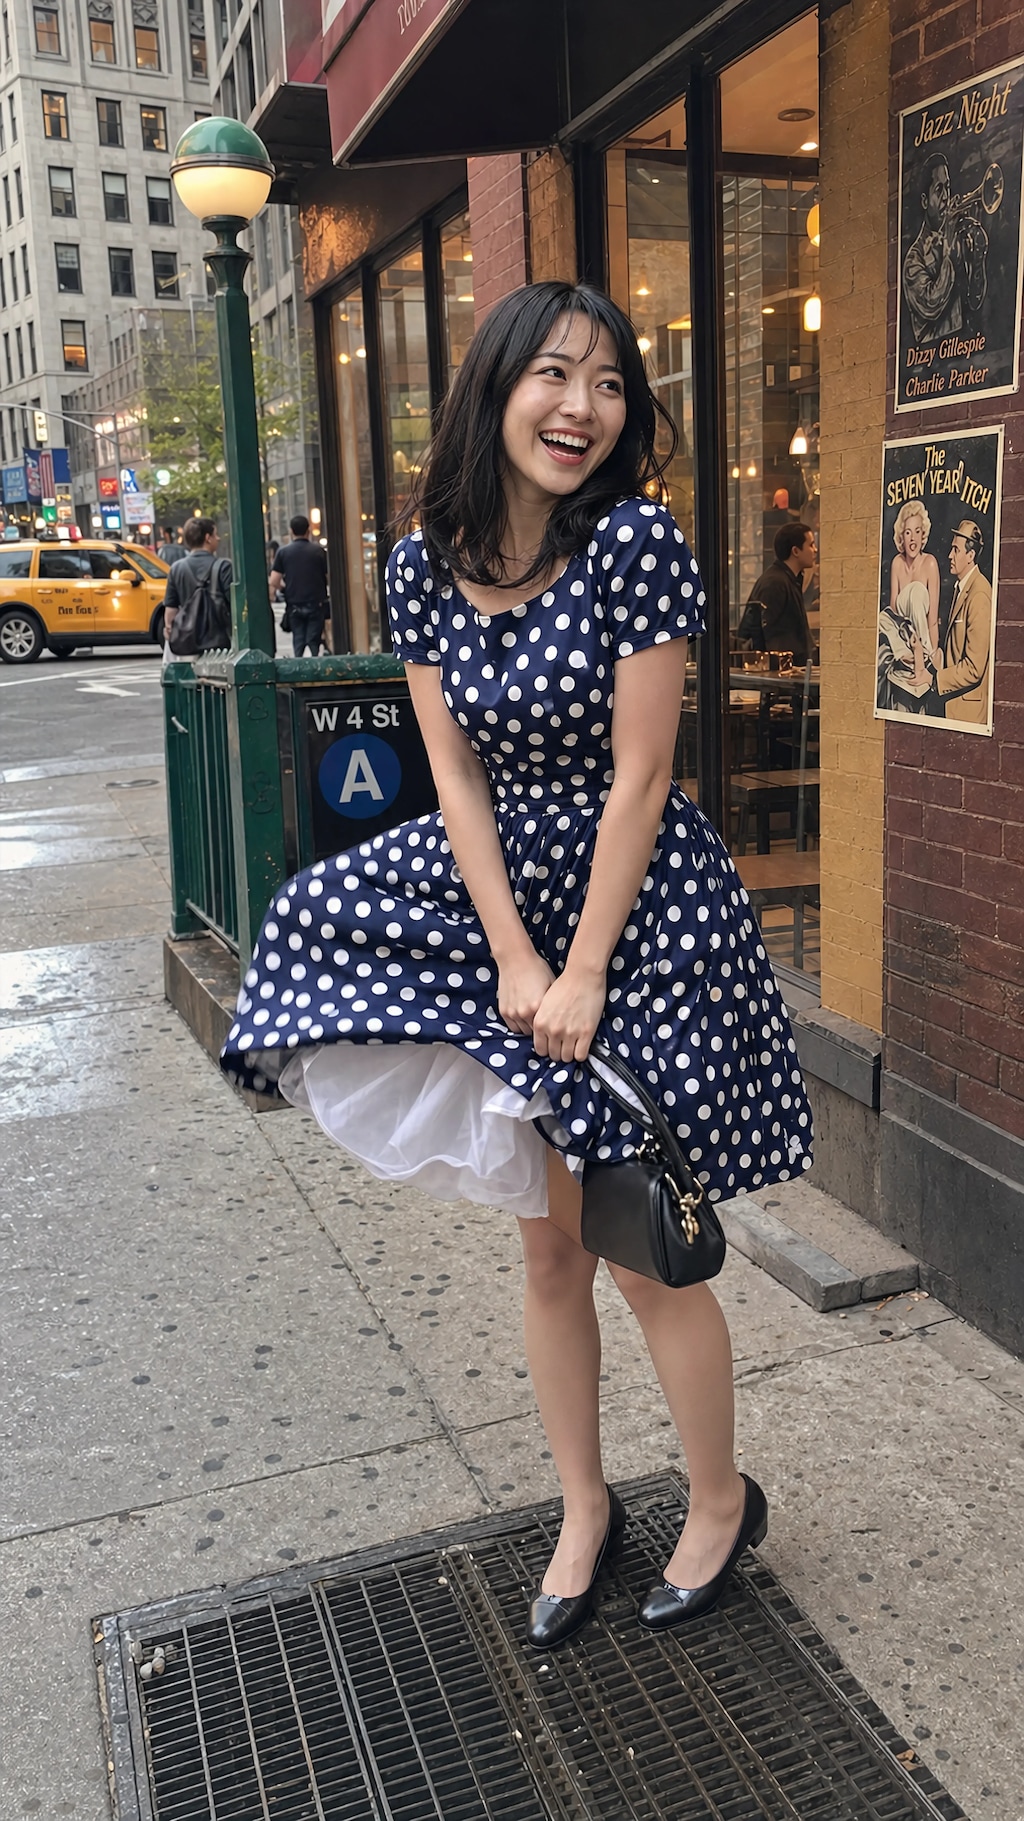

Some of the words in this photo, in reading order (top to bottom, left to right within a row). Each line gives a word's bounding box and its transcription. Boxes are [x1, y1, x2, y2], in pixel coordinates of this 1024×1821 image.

[914, 111, 953, 147] Jazz
[957, 81, 1011, 134] Night
[906, 347, 936, 367] Dizzy
[939, 332, 985, 359] Gillespie
[905, 373, 945, 397] Charlie
[948, 365, 989, 389] Parker
[925, 445, 946, 468] The
[960, 475, 993, 514] ITCH
[311, 706, 339, 732] W
[346, 705, 364, 729] 4
[372, 703, 400, 728] St
[339, 749, 384, 803] A
